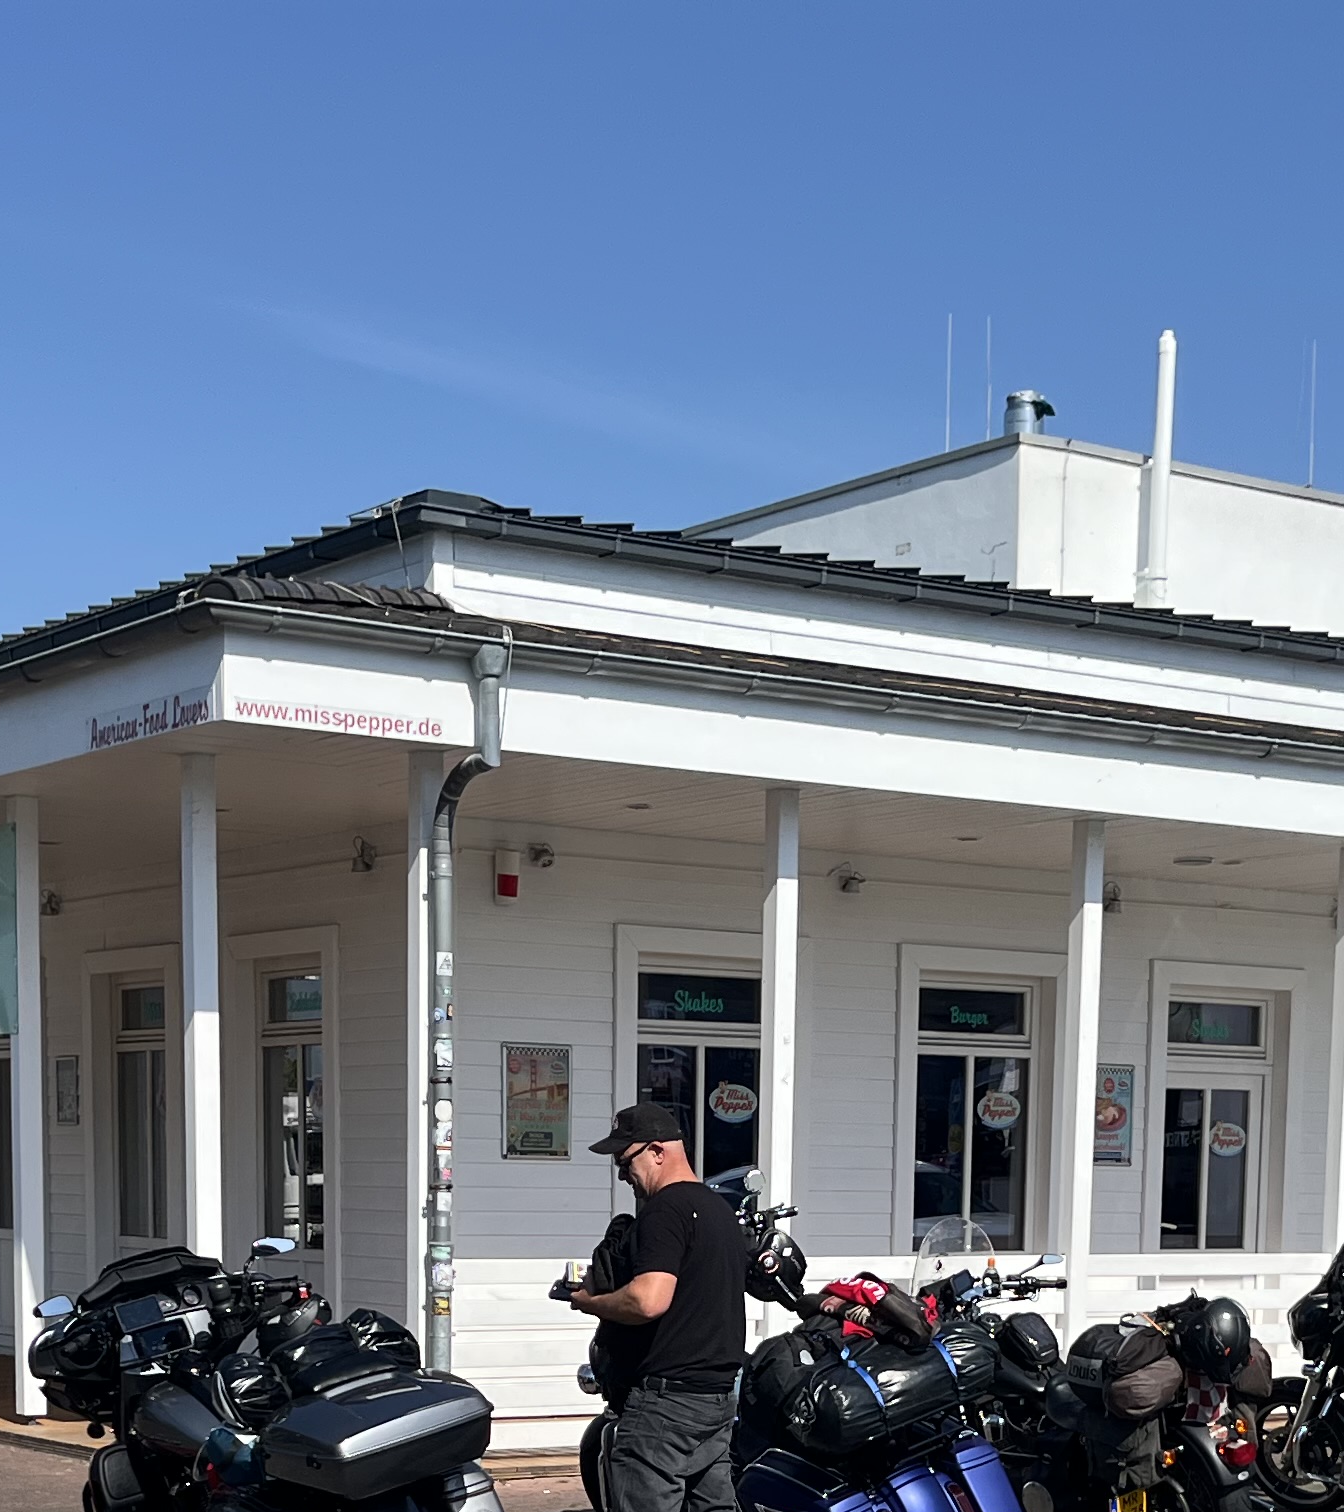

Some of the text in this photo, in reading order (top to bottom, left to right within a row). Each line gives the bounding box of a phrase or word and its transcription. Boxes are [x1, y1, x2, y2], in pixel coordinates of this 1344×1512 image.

[90, 695, 209, 750] American-Food Lovers
[235, 700, 443, 738] www.misspepper.de
[674, 989, 724, 1013] Shakes
[950, 1005, 989, 1026] Burger
[726, 1089, 750, 1100] Miss
[1068, 1360, 1098, 1381] Louis
[1122, 1492, 1138, 1509] MR
